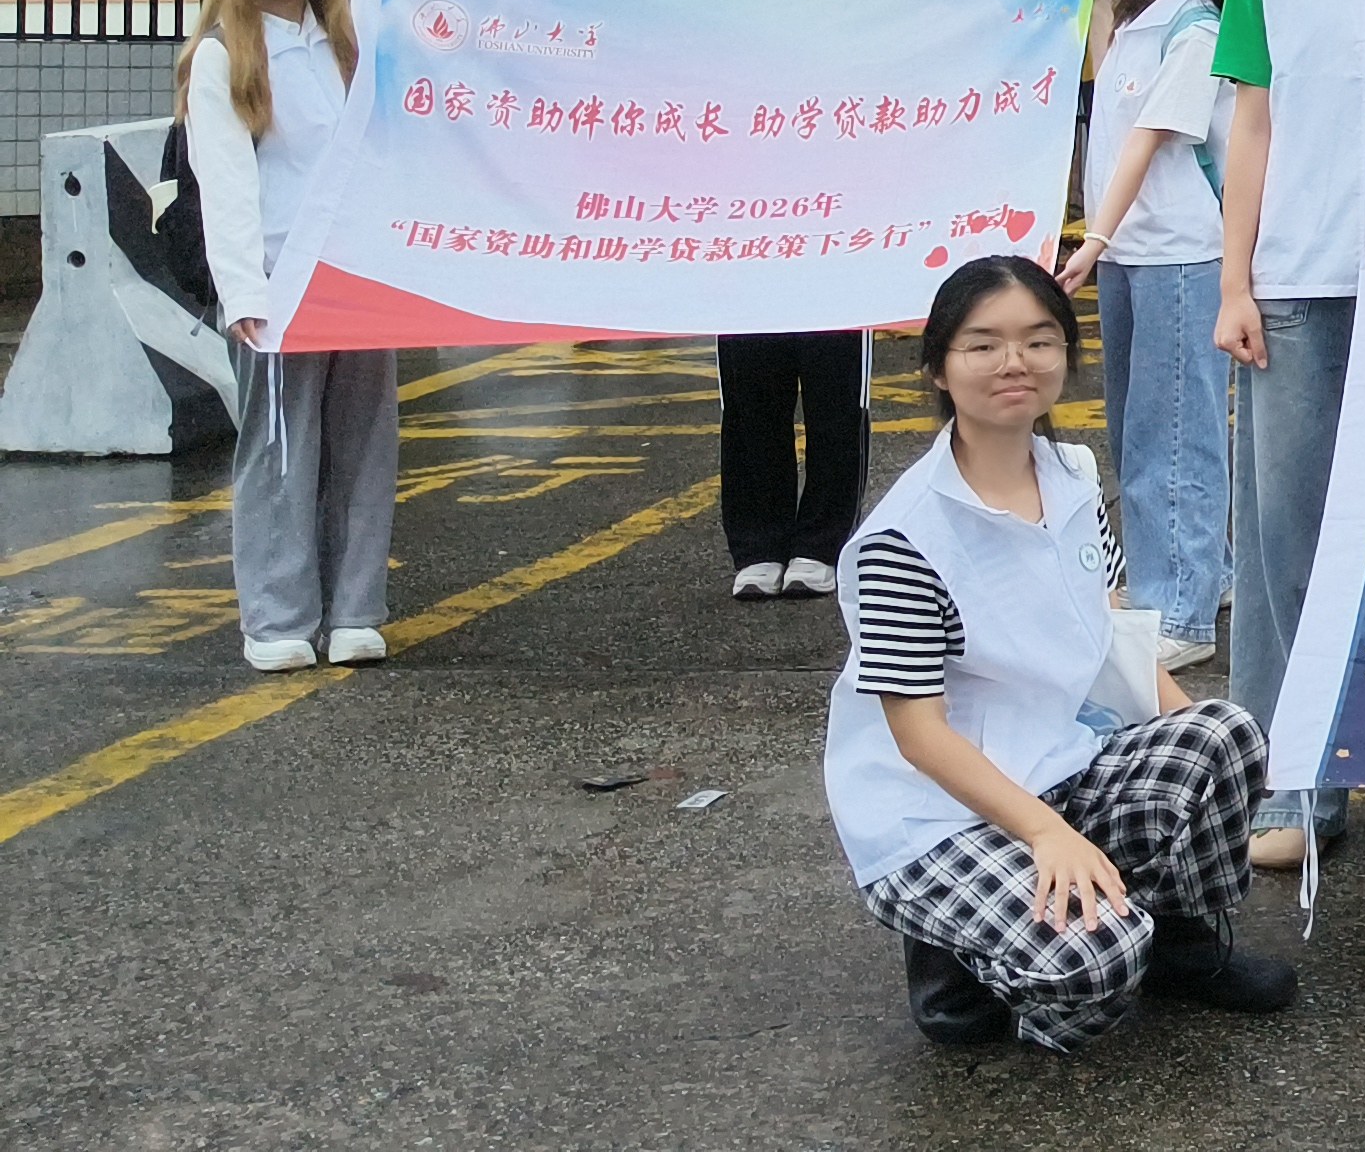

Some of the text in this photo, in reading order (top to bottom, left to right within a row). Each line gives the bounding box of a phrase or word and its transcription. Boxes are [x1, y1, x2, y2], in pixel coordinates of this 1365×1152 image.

[477, 39, 596, 58] FOSHAN UNIVERSITY
[403, 67, 1057, 142] 国家资助伴你成长 助学贷款助力成才
[575, 191, 843, 224] 佛山大学 2026年
